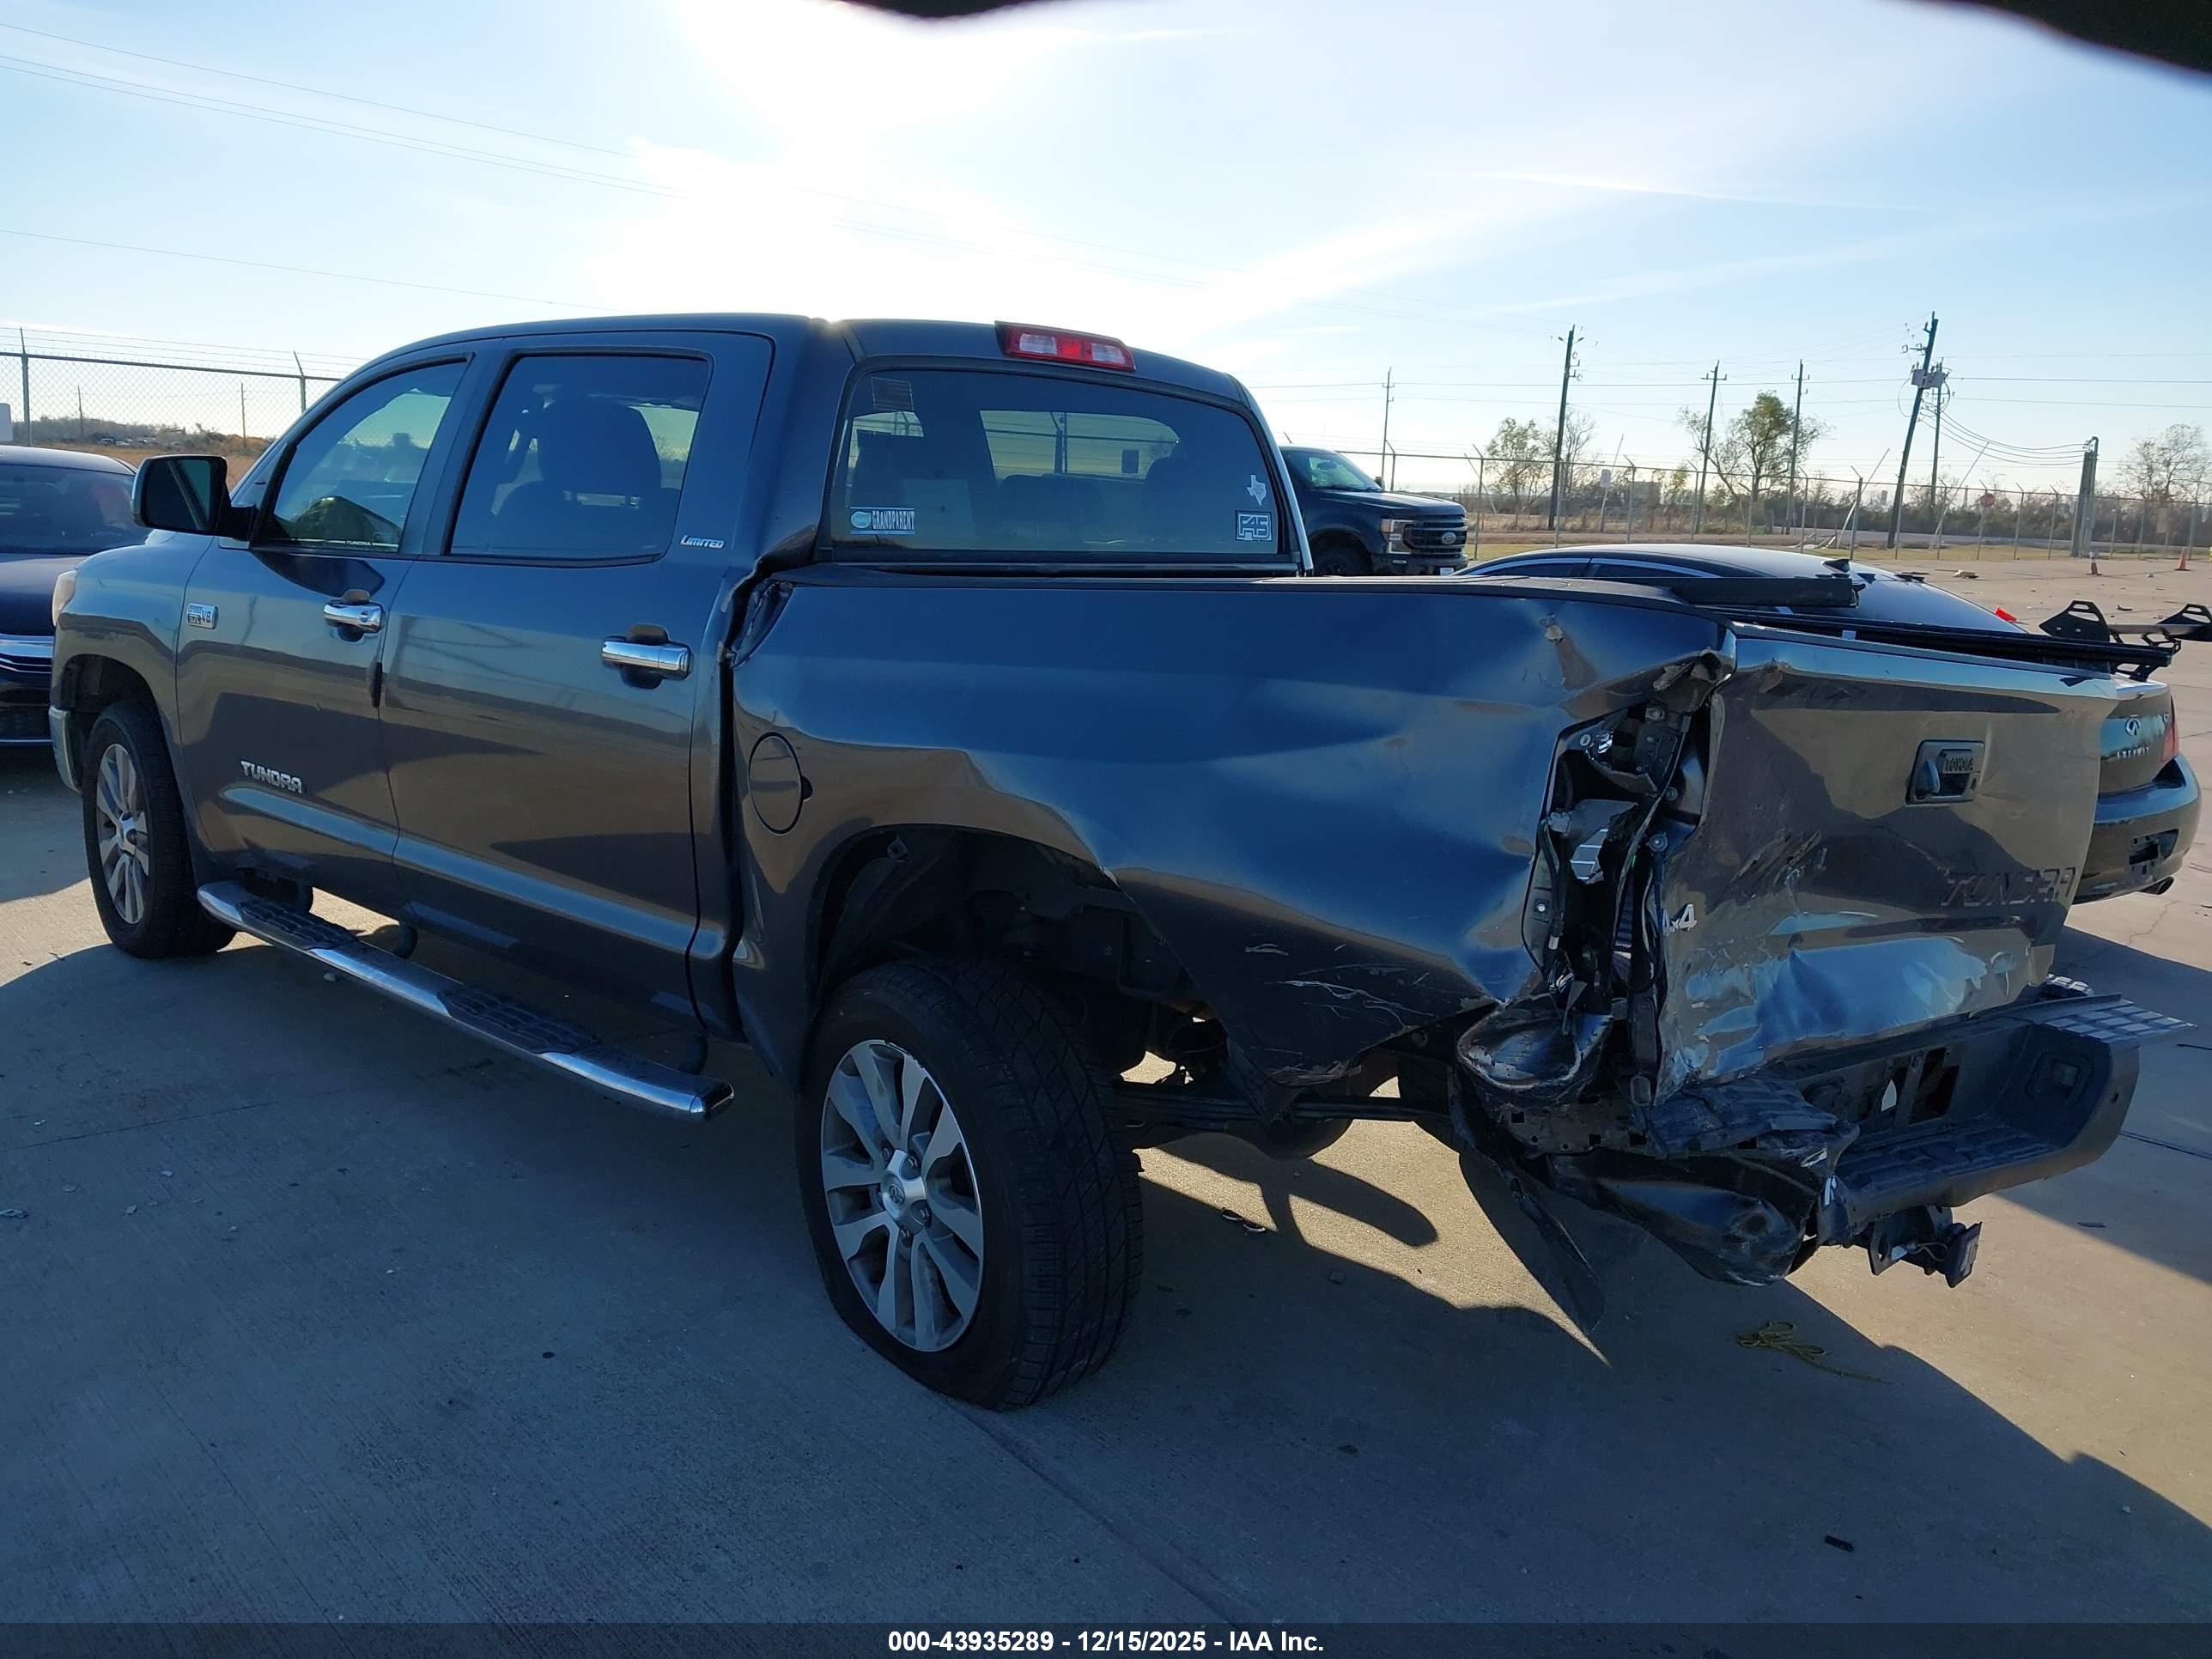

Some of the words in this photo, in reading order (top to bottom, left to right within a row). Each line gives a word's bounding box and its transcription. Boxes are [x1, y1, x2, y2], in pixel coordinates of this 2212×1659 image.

[872, 510, 915, 530] GRANDPARENT
[1238, 514, 1270, 538] F45
[1943, 756, 1974, 772] TOYOTA
[240, 760, 302, 793] TUNDRA
